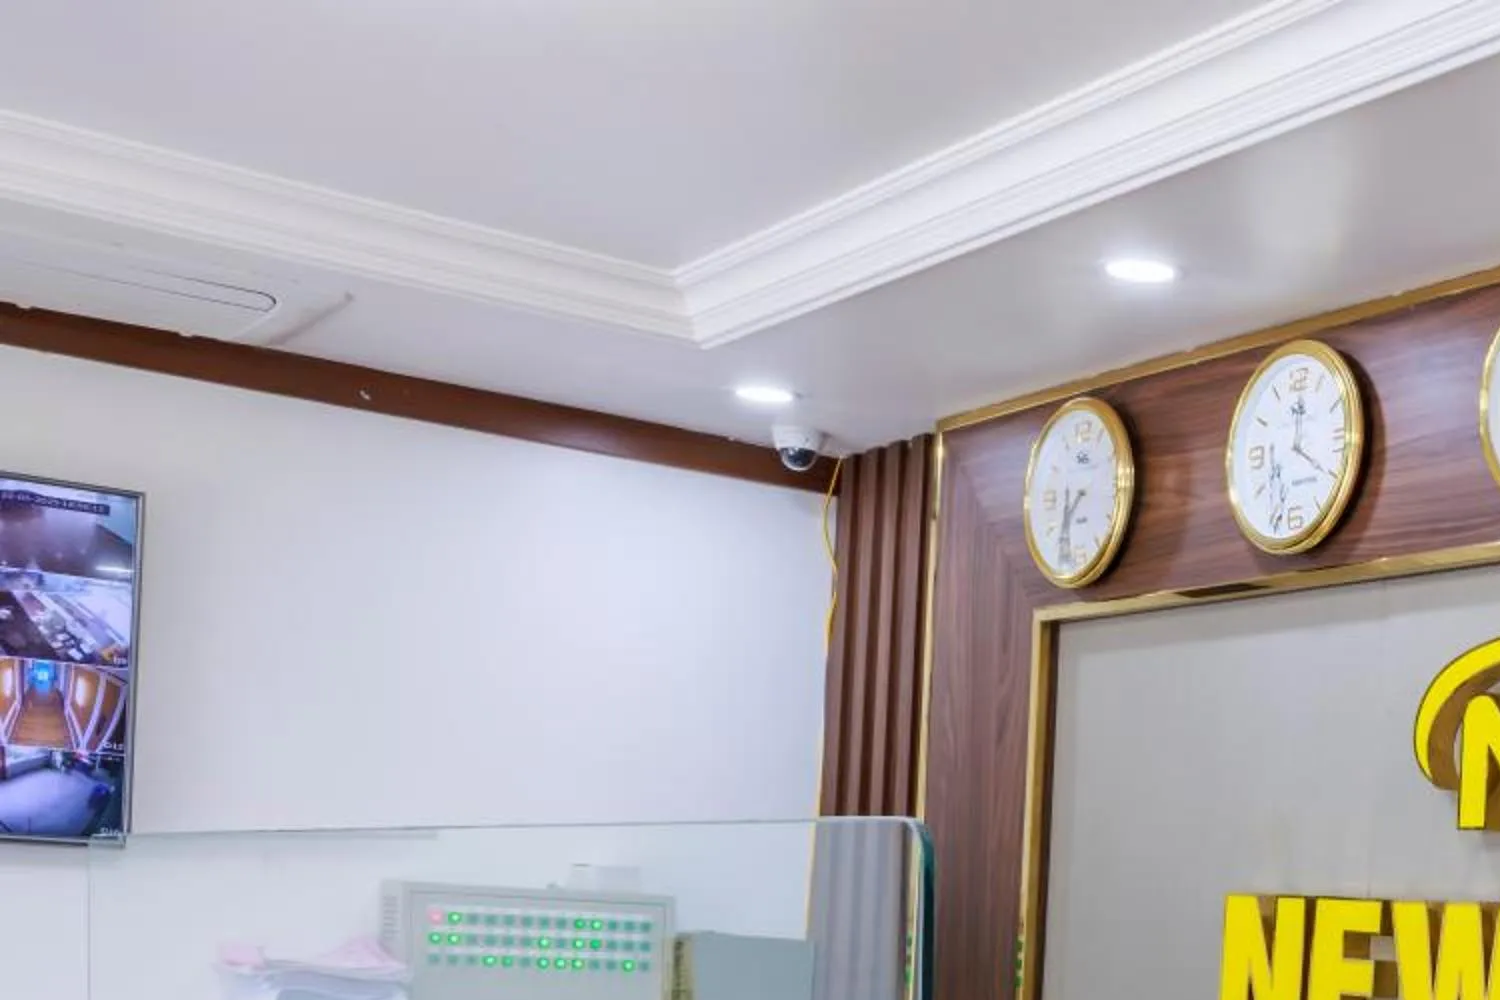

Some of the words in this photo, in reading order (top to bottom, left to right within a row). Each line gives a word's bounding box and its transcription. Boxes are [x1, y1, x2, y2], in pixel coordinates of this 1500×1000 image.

[1288, 367, 1309, 392] 12
[1249, 445, 1265, 470] 9
[1287, 505, 1304, 530] 6
